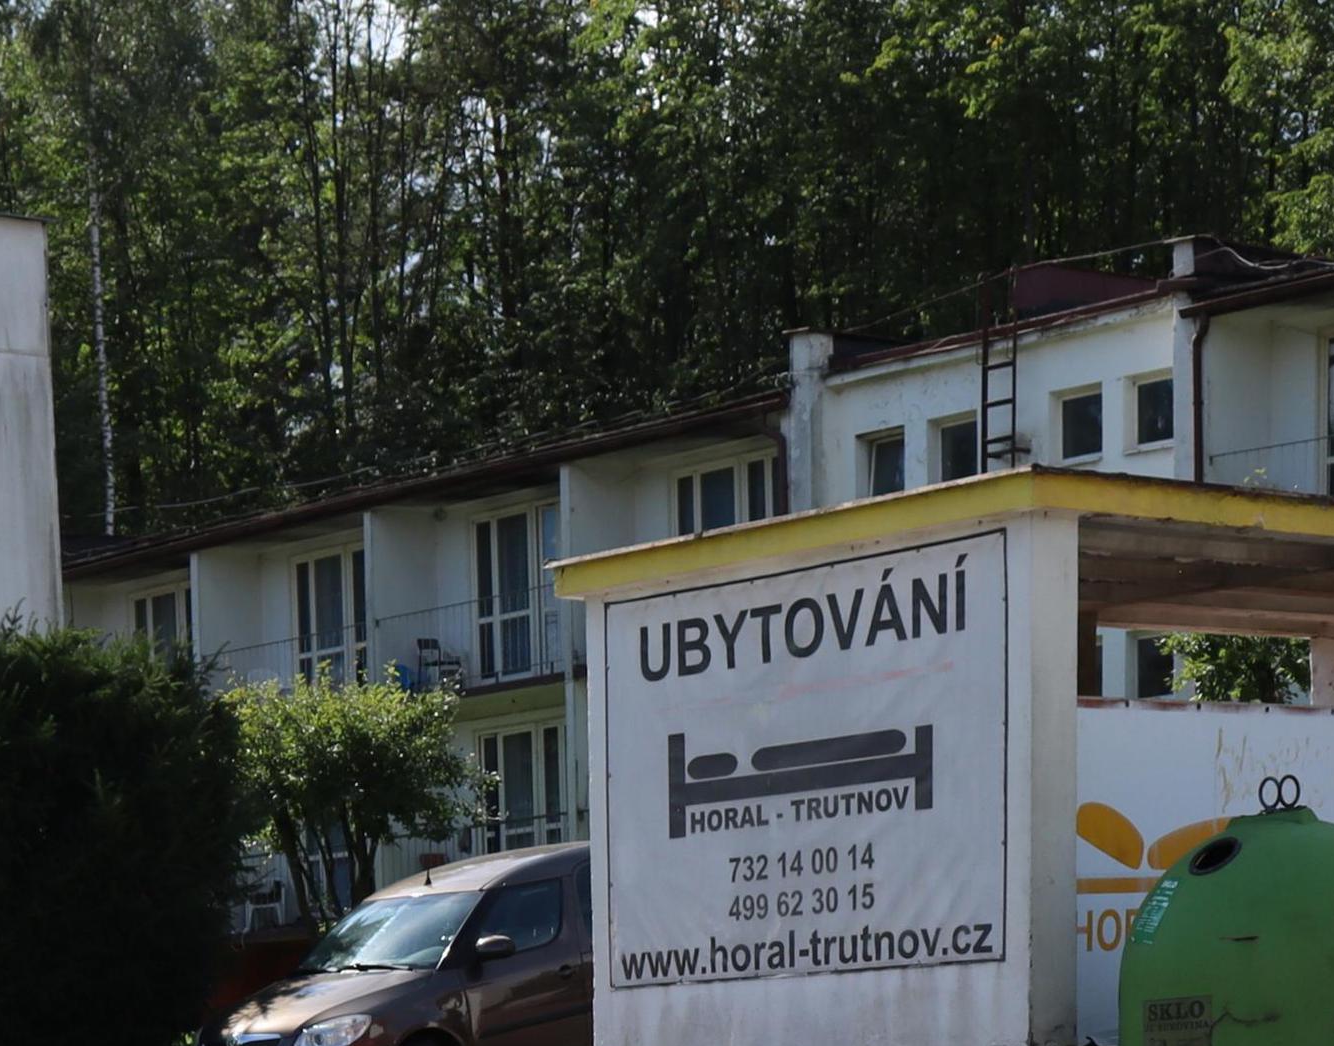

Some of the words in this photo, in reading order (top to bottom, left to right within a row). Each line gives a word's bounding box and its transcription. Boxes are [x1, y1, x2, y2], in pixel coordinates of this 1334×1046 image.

[640, 554, 968, 682] UBYTOVÁNÍ
[690, 804, 769, 834] HORAL
[790, 785, 911, 822] TRUTNOV
[729, 854, 768, 883] 732
[777, 851, 803, 879] 14
[812, 847, 838, 875] 00
[847, 843, 875, 870] 14
[728, 894, 768, 922] 499
[777, 890, 803, 917] 62
[812, 887, 838, 914] 30
[847, 883, 875, 910] 15
[621, 922, 993, 981] www.horal-trutnov.cz
[1148, 1000, 1205, 1021] SKLO
